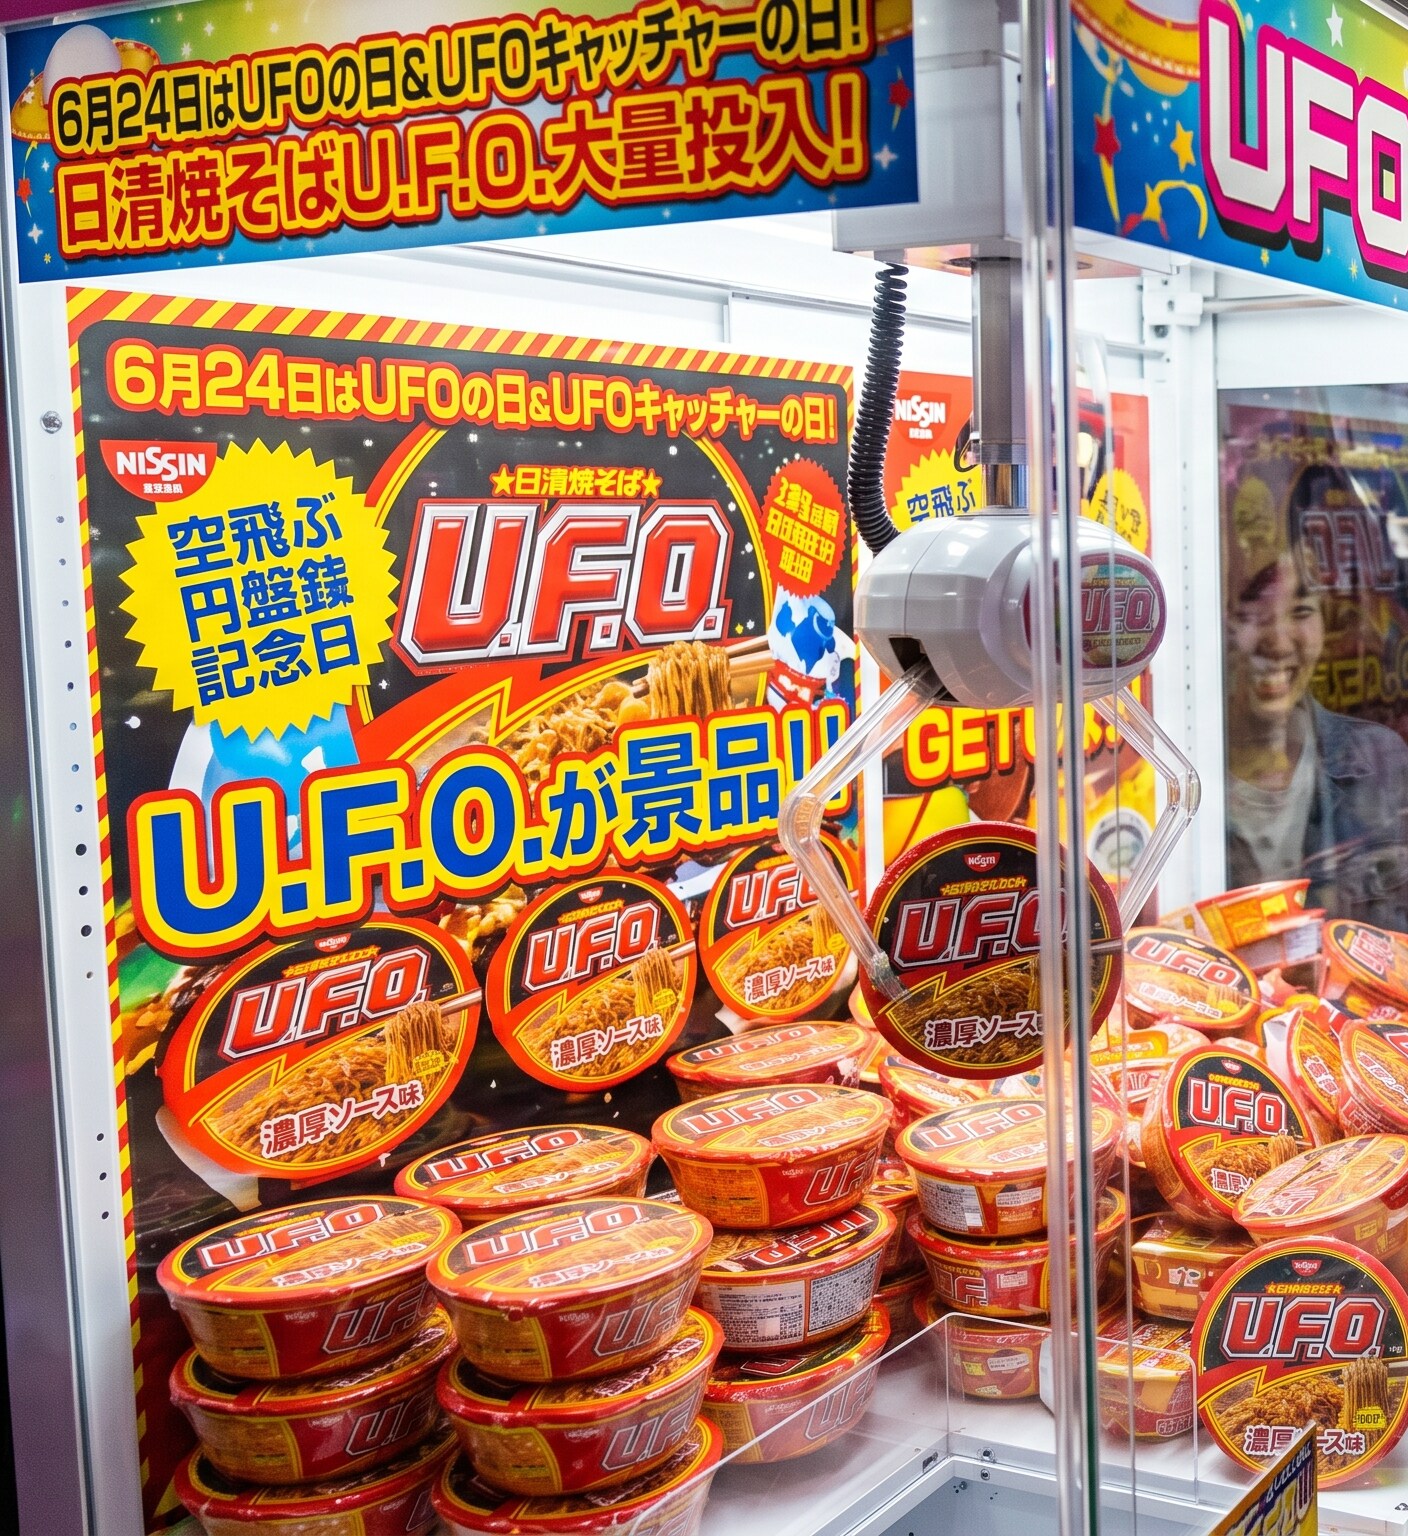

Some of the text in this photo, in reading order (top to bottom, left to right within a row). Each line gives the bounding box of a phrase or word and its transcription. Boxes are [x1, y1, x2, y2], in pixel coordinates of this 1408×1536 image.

[56, 0, 862, 149] 6月24日はUFOの日&UFOキャッチャーの日!
[61, 80, 856, 248] 日清焼そばU.F.O.大量投入!
[112, 343, 837, 441] 6月24日はUFOの日&UFOキャッチャーの日!
[894, 395, 946, 427] NISSIN
[115, 446, 207, 482] NISSIN
[167, 491, 343, 578] 空飛ぶ
[190, 614, 361, 706] 記念日
[552, 1015, 663, 1070] 濃厚ソース味
[925, 1010, 1044, 1049] 濃厚ソース
[262, 1082, 423, 1158] 濃厚ソース味
[1245, 1426, 1366, 1456] 濃厚ース味
